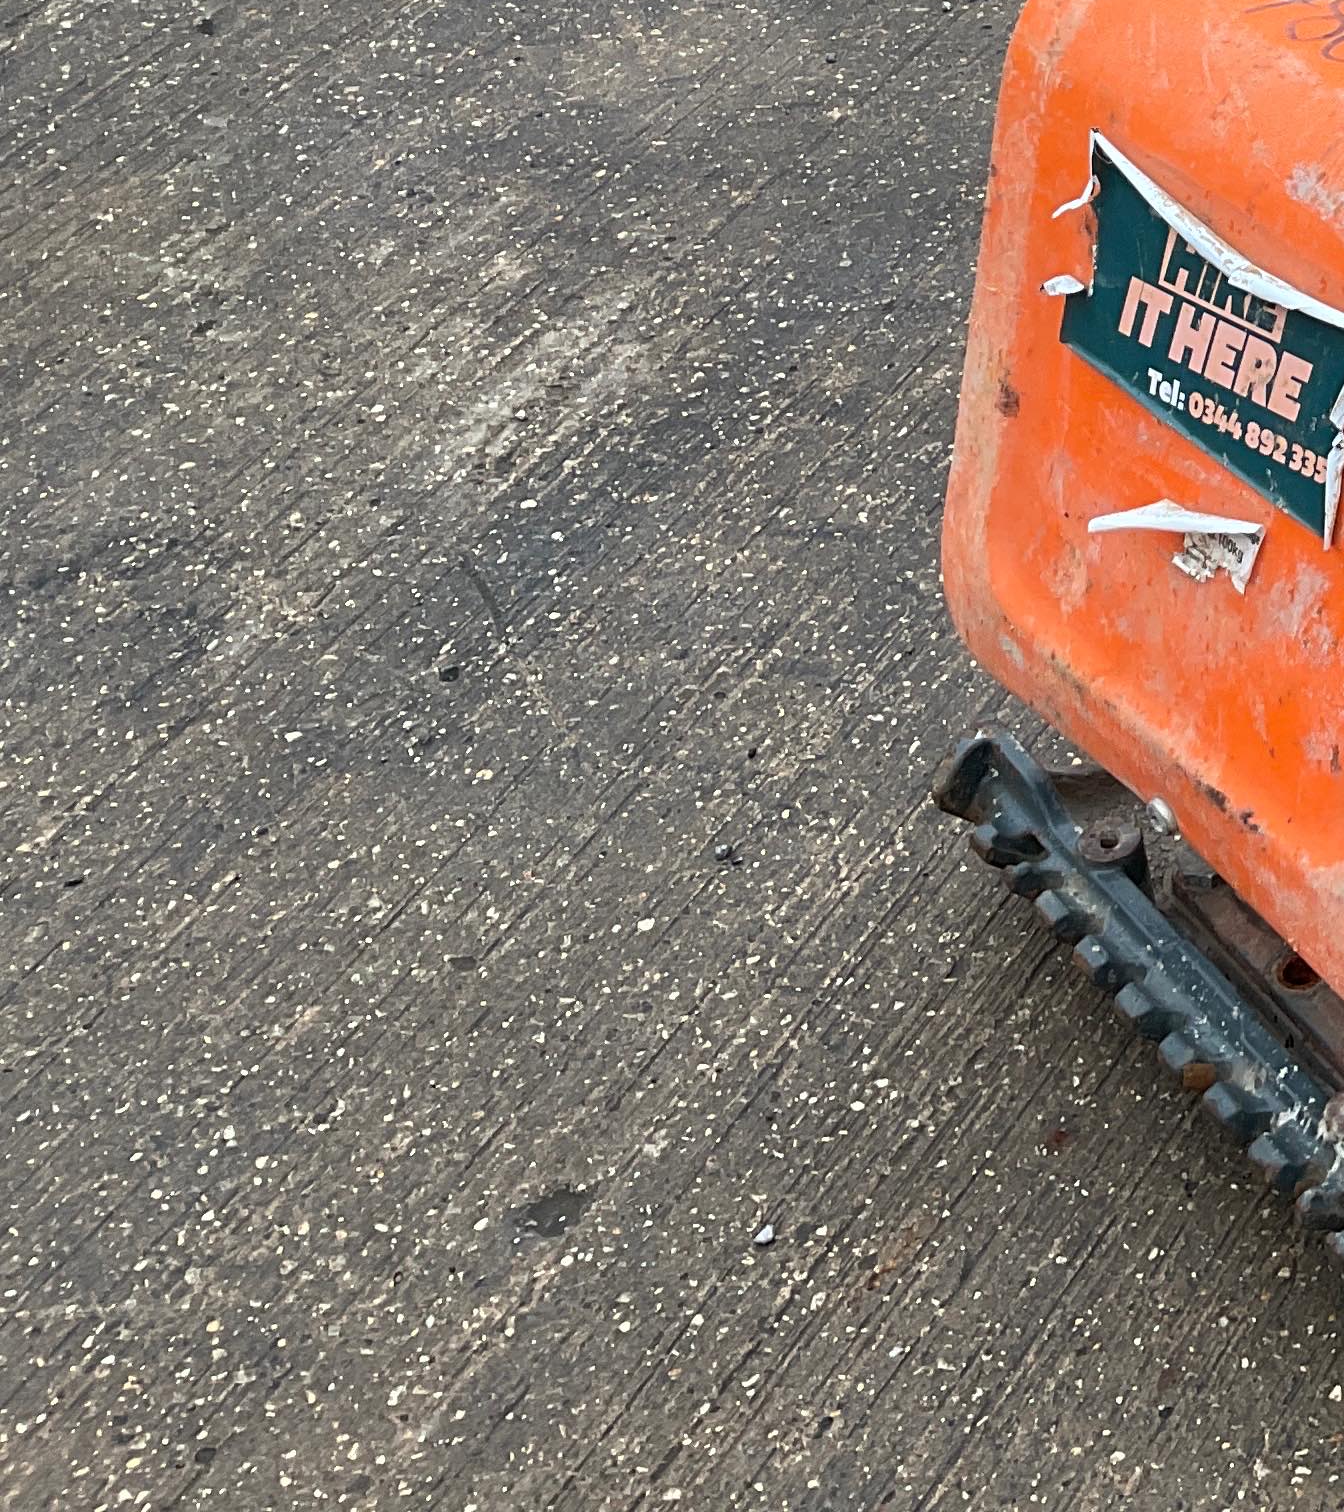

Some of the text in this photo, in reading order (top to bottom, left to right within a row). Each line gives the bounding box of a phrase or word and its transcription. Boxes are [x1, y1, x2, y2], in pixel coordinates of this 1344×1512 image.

[1117, 275, 1314, 423] IT HERE
[1147, 367, 1187, 411] Tel:
[1188, 391, 1243, 441] 0344
[1244, 421, 1289, 465] 892
